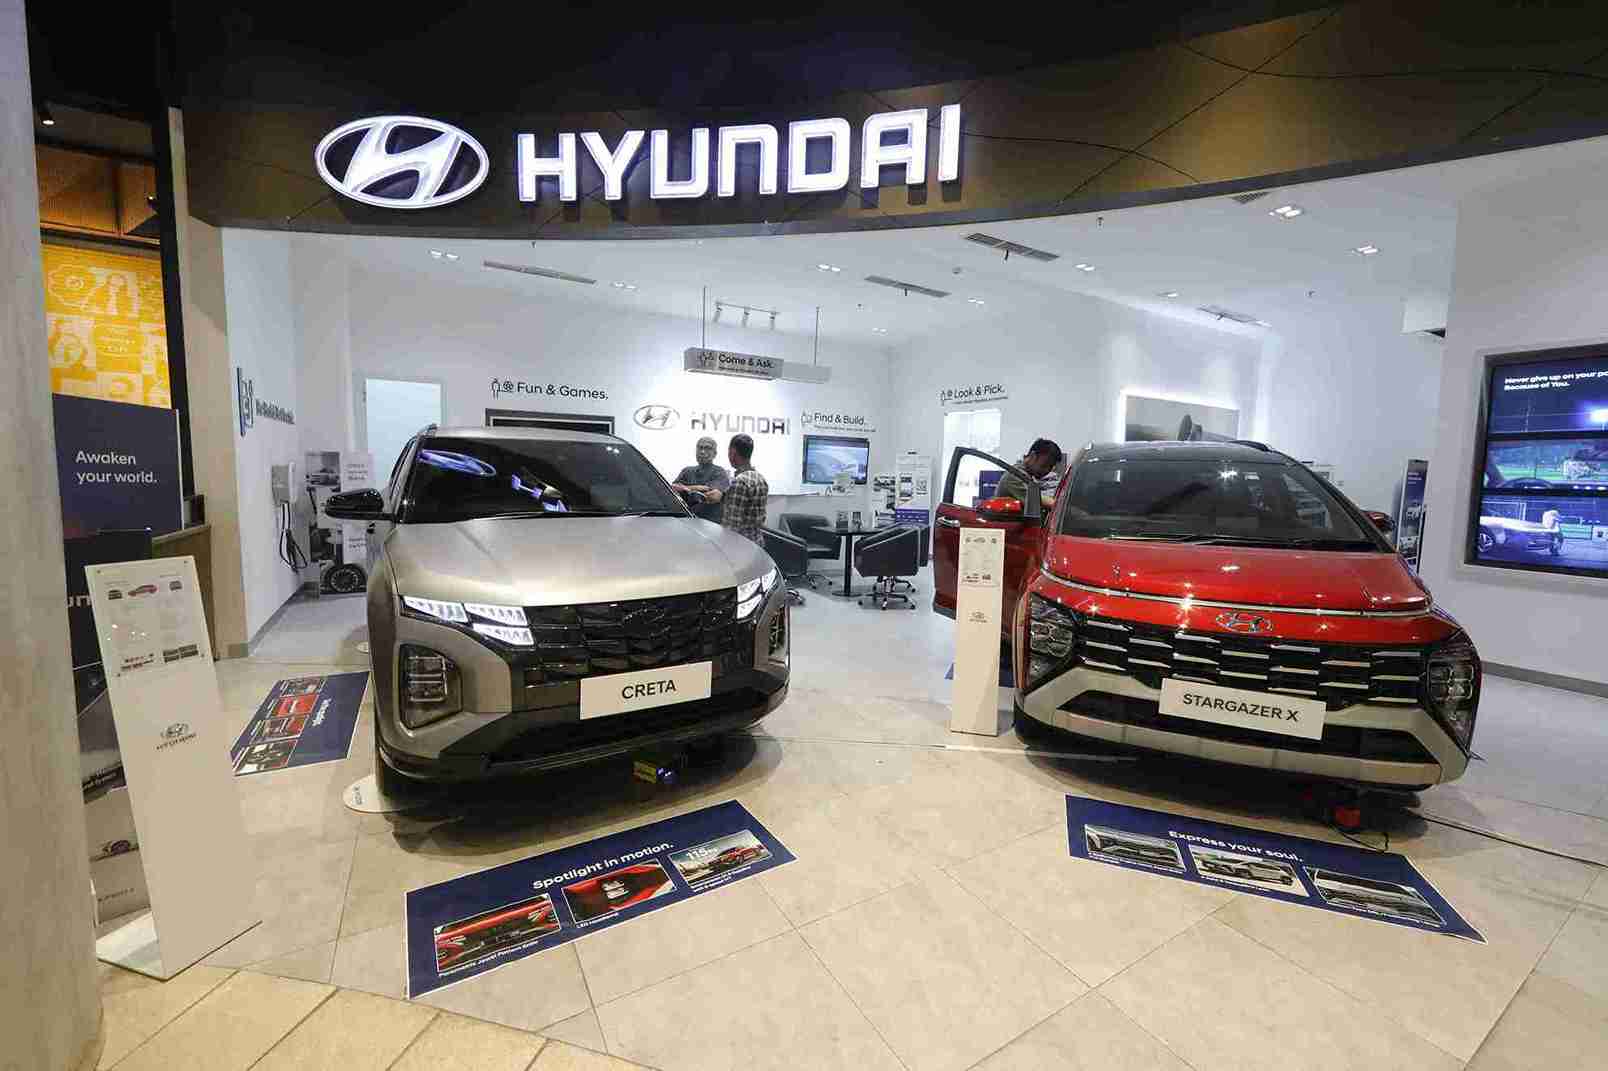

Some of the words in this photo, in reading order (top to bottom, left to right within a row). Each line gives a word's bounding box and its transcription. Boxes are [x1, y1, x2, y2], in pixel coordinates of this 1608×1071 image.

[517, 104, 961, 202] HYUNDAI
[719, 354, 746, 366] Come
[1575, 372, 1596, 380] your
[517, 381, 543, 394] Fun
[546, 384, 556, 395] &
[954, 387, 973, 399] Look
[975, 385, 982, 396] &
[1504, 383, 1540, 391] Because
[691, 410, 790, 435] HYUNDAI
[814, 412, 833, 423] Find
[835, 414, 842, 424] &
[75, 450, 137, 465] Awaken
[76, 471, 112, 485] your
[115, 471, 158, 483] world.
[621, 679, 677, 699] CRETA
[1183, 693, 1283, 720] STARGAZER
[1286, 709, 1299, 722] X
[1168, 830, 1226, 847] Express
[1228, 842, 1262, 854] your
[1264, 850, 1303, 862] soul.
[532, 860, 604, 889] Spotlight
[604, 857, 619, 869] in
[620, 842, 674, 863] motion.
